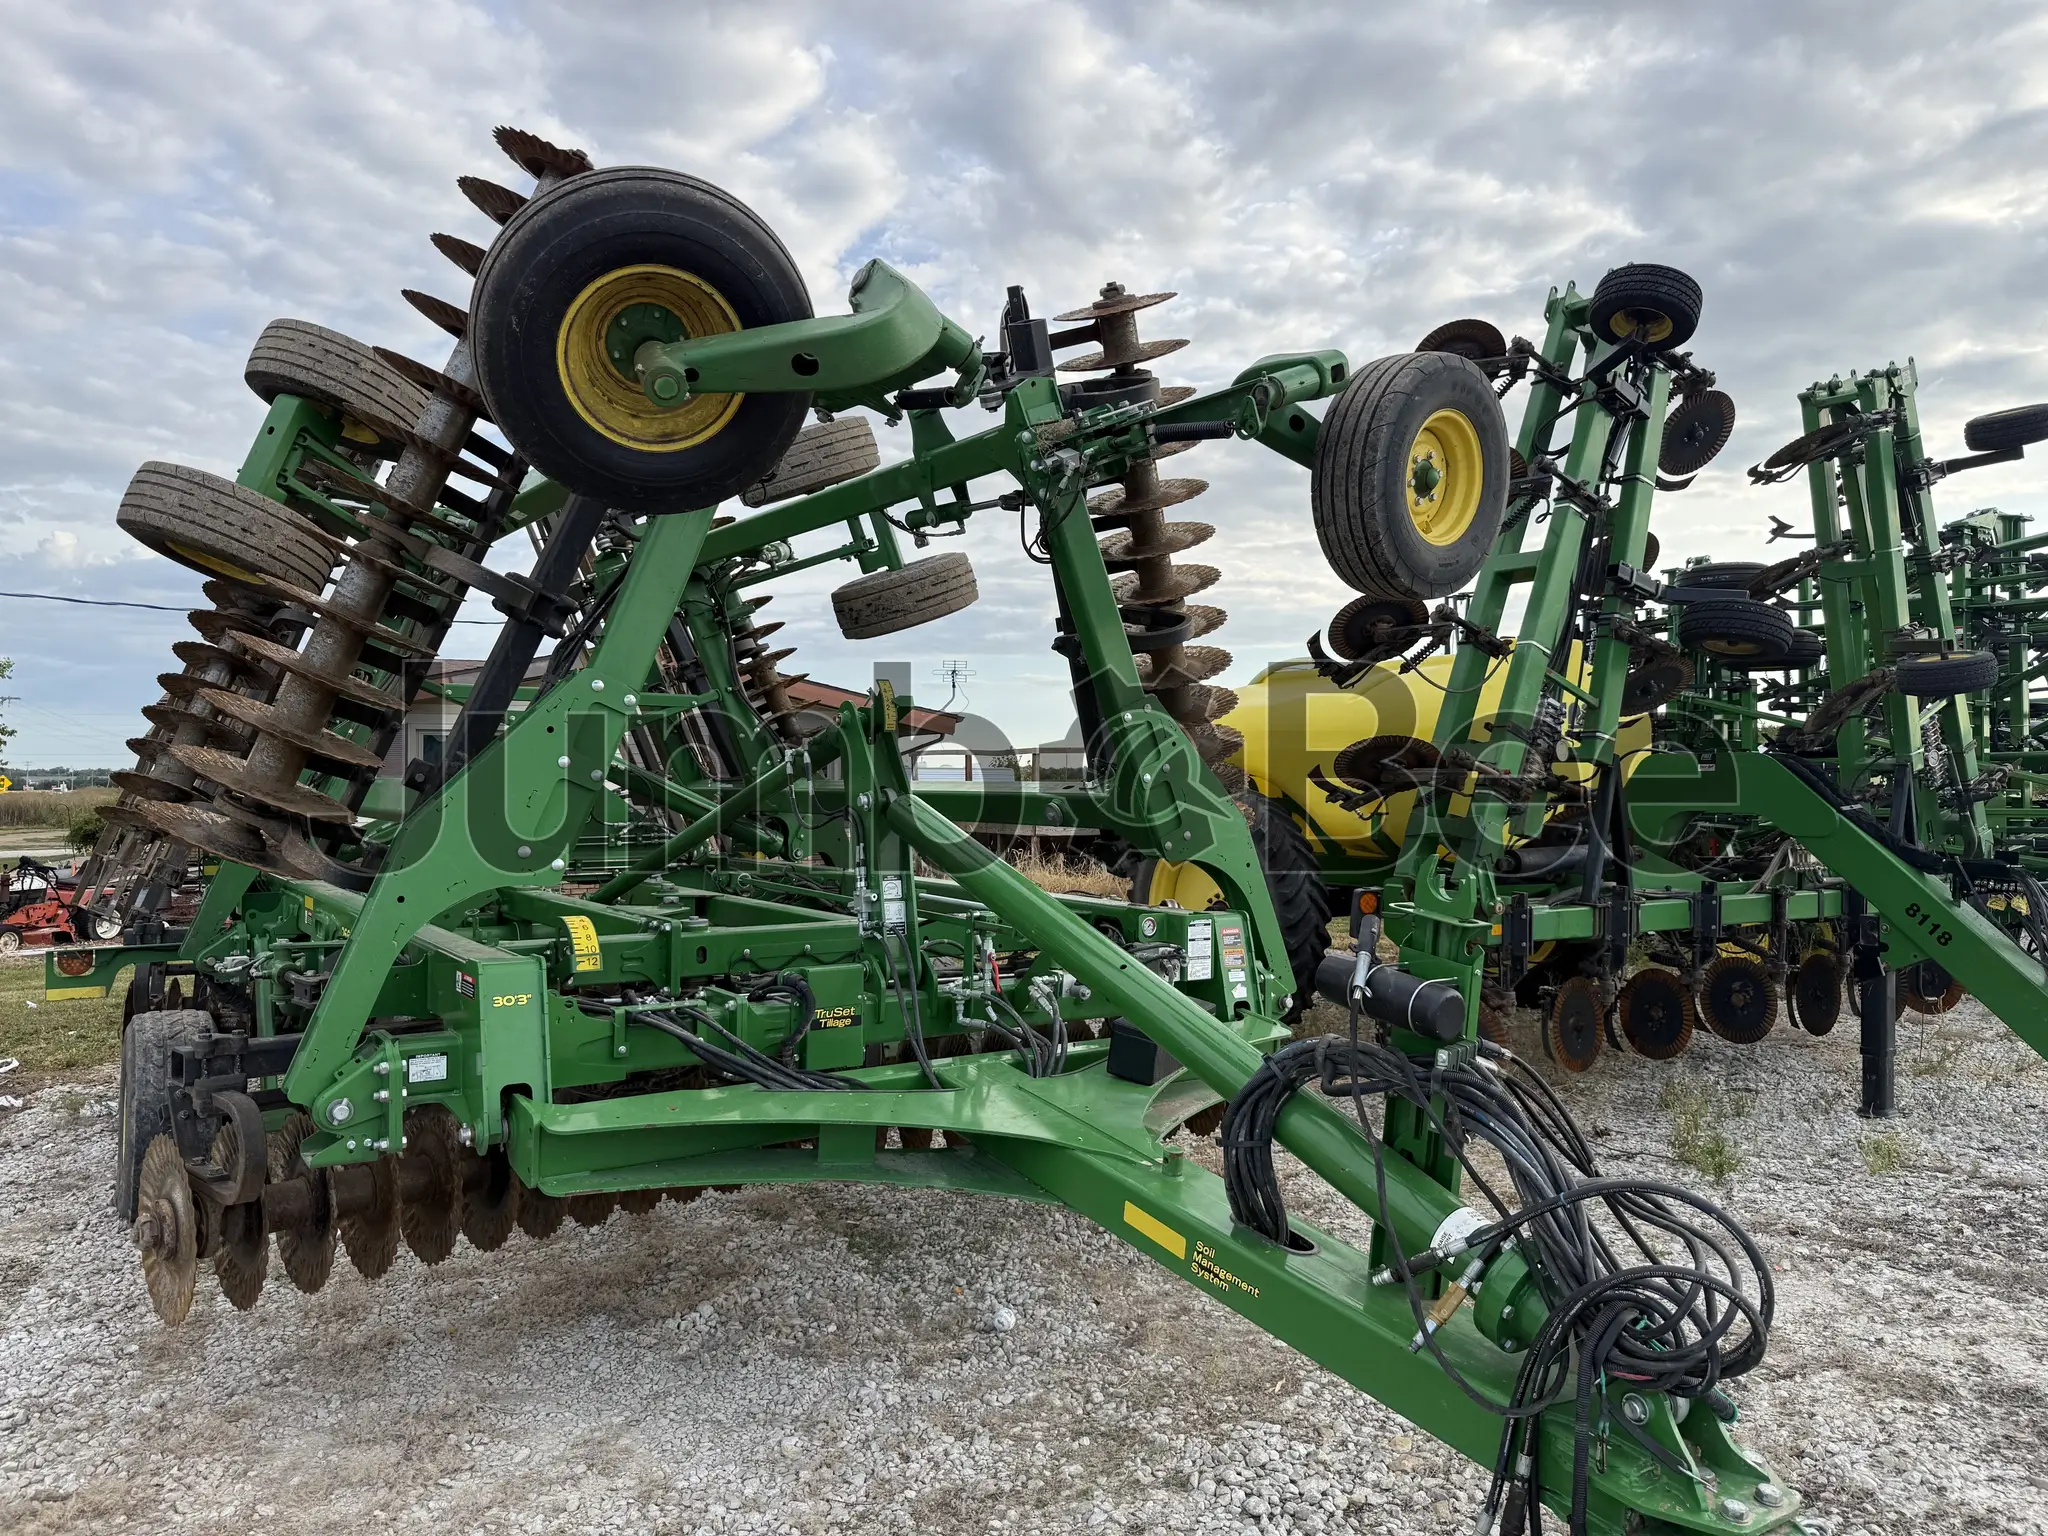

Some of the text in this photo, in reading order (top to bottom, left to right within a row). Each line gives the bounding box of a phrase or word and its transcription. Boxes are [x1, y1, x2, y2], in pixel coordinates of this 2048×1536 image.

[1905, 902, 1953, 947] 8118
[585, 933, 592, 942] 8
[585, 944, 597, 954] 10
[586, 956, 598, 966] 12
[814, 1006, 856, 1019] TruSet
[819, 1017, 852, 1028] Tillage
[1195, 1240, 1216, 1259] Soil
[1190, 1262, 1229, 1292] System
[1192, 1251, 1260, 1298] Management
